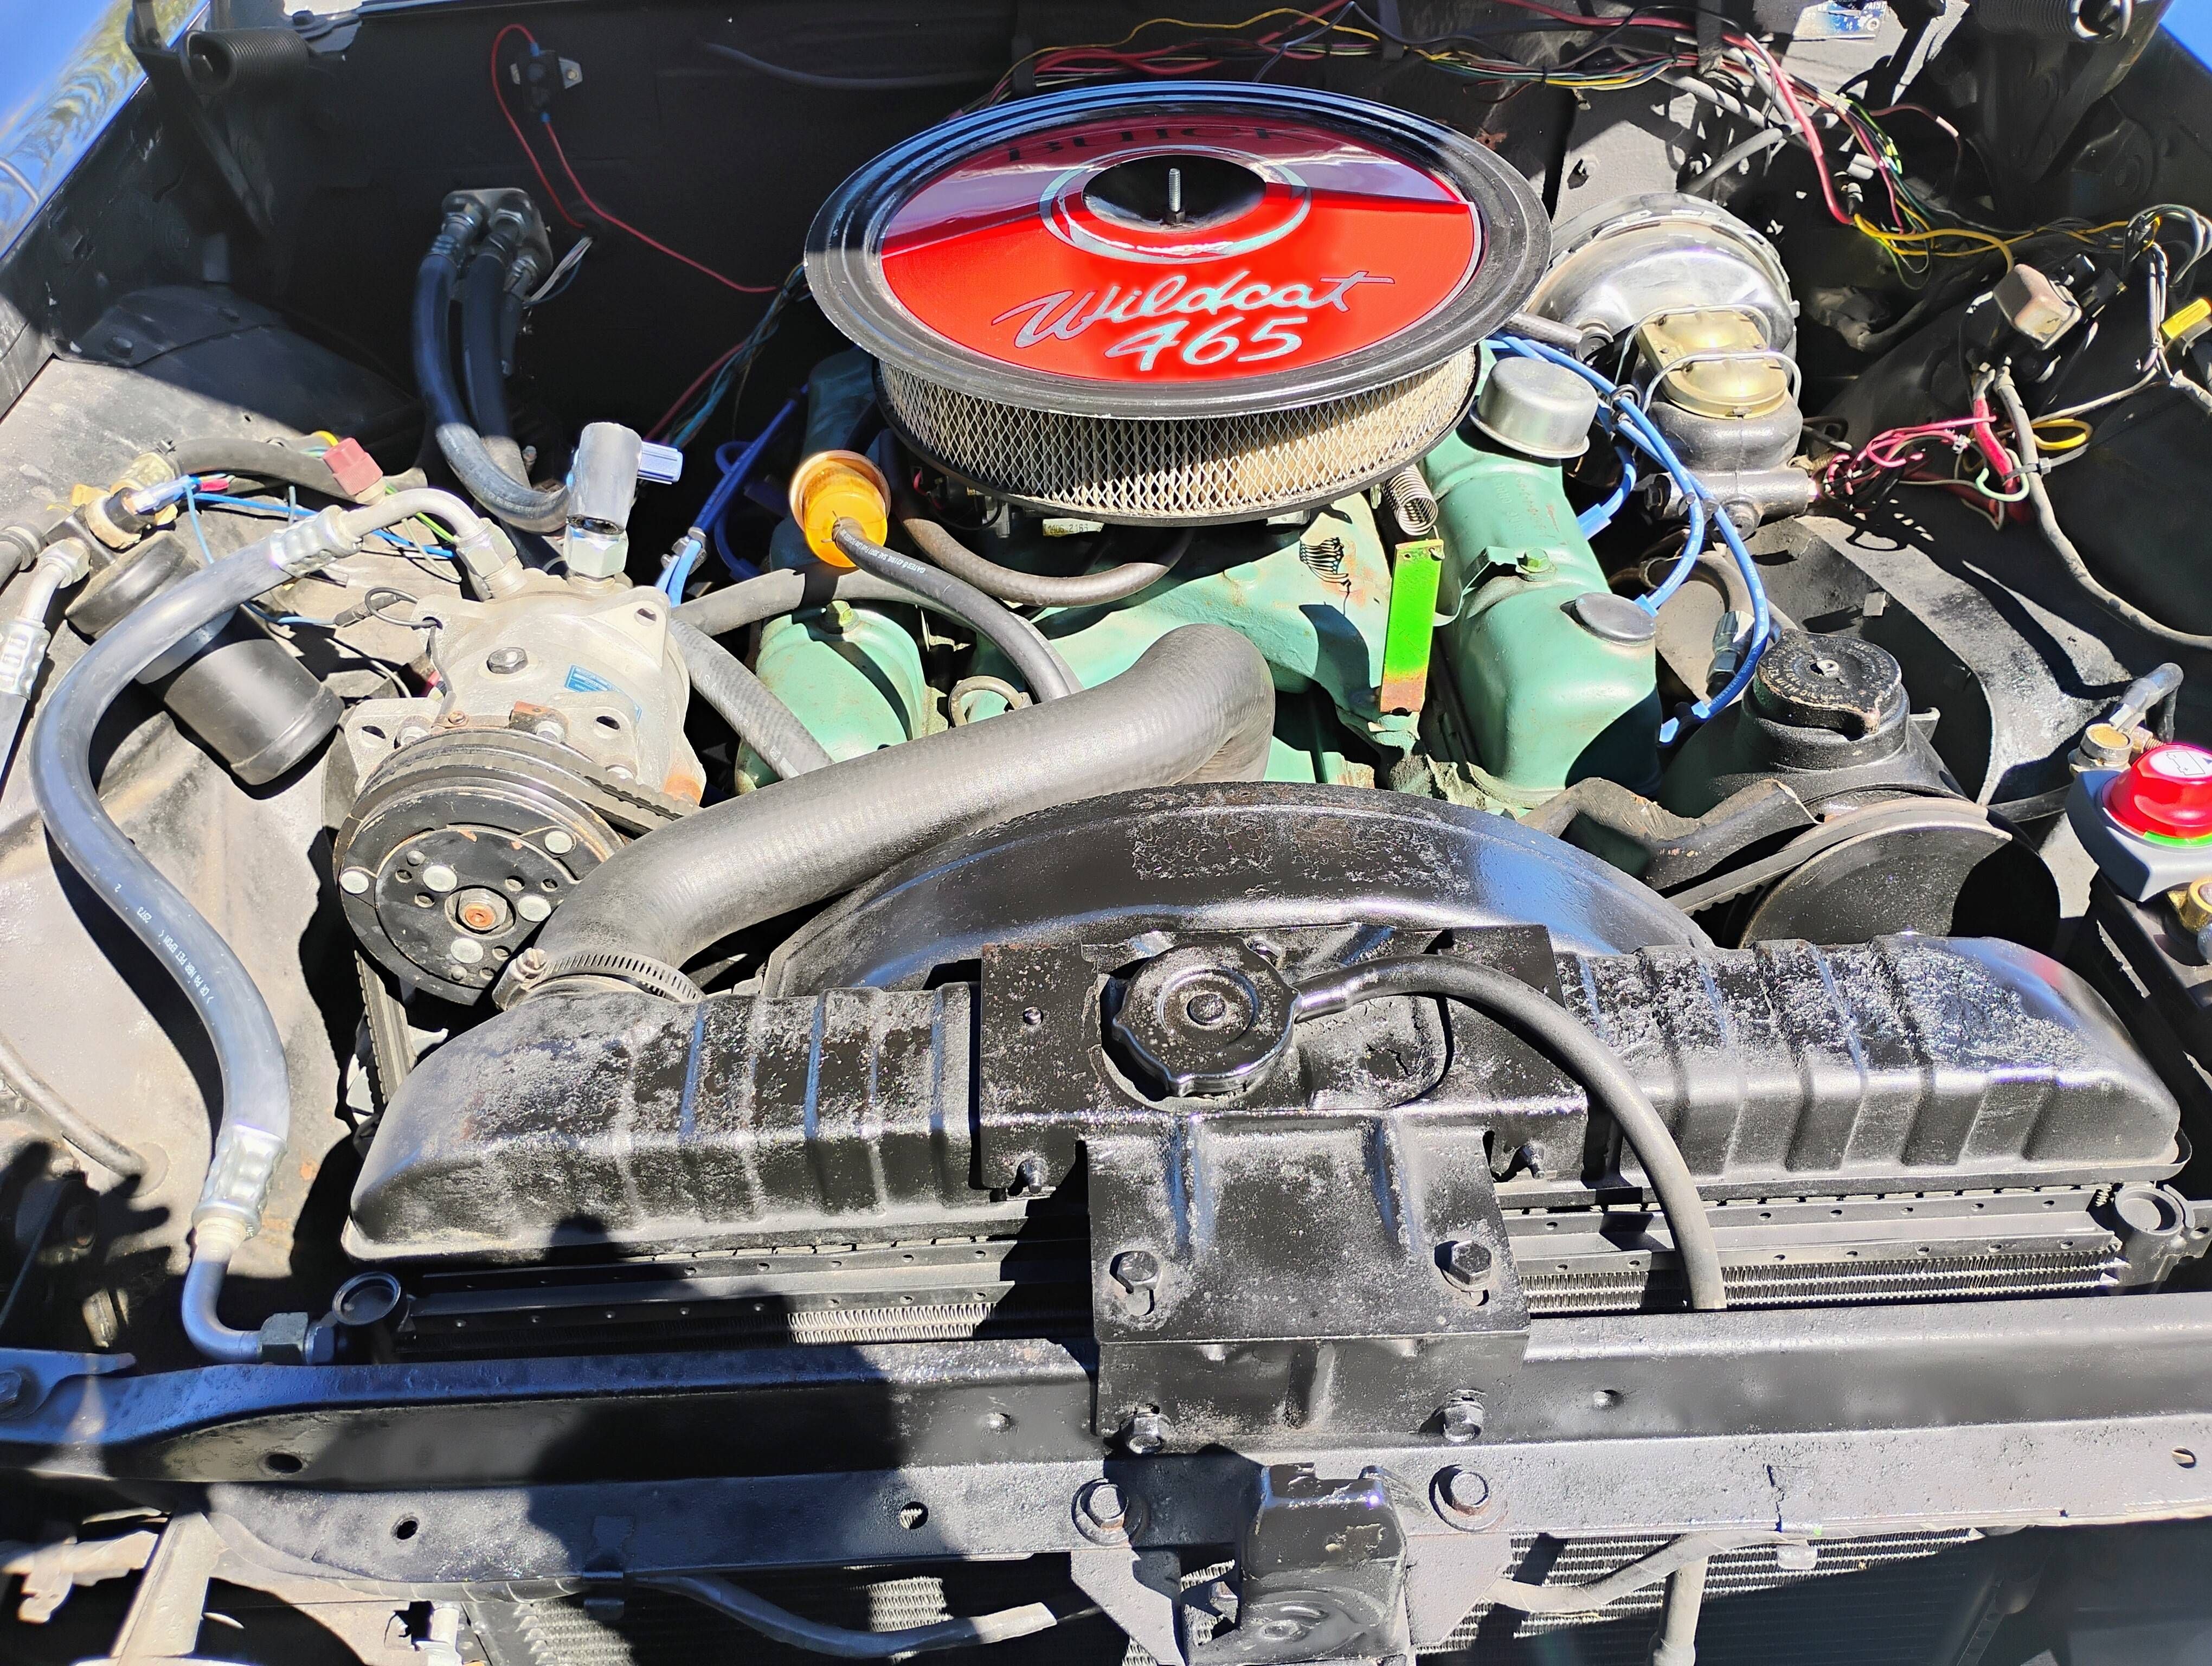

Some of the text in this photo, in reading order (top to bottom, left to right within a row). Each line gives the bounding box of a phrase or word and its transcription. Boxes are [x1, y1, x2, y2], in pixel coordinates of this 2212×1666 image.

[1007, 127, 1321, 162] BUICK
[992, 270, 1396, 349] Wildcat
[1104, 316, 1309, 371] 465
[907, 562, 926, 573] GATES
[114, 883, 210, 997] CR PA NBR PET EPDM 2973 2
